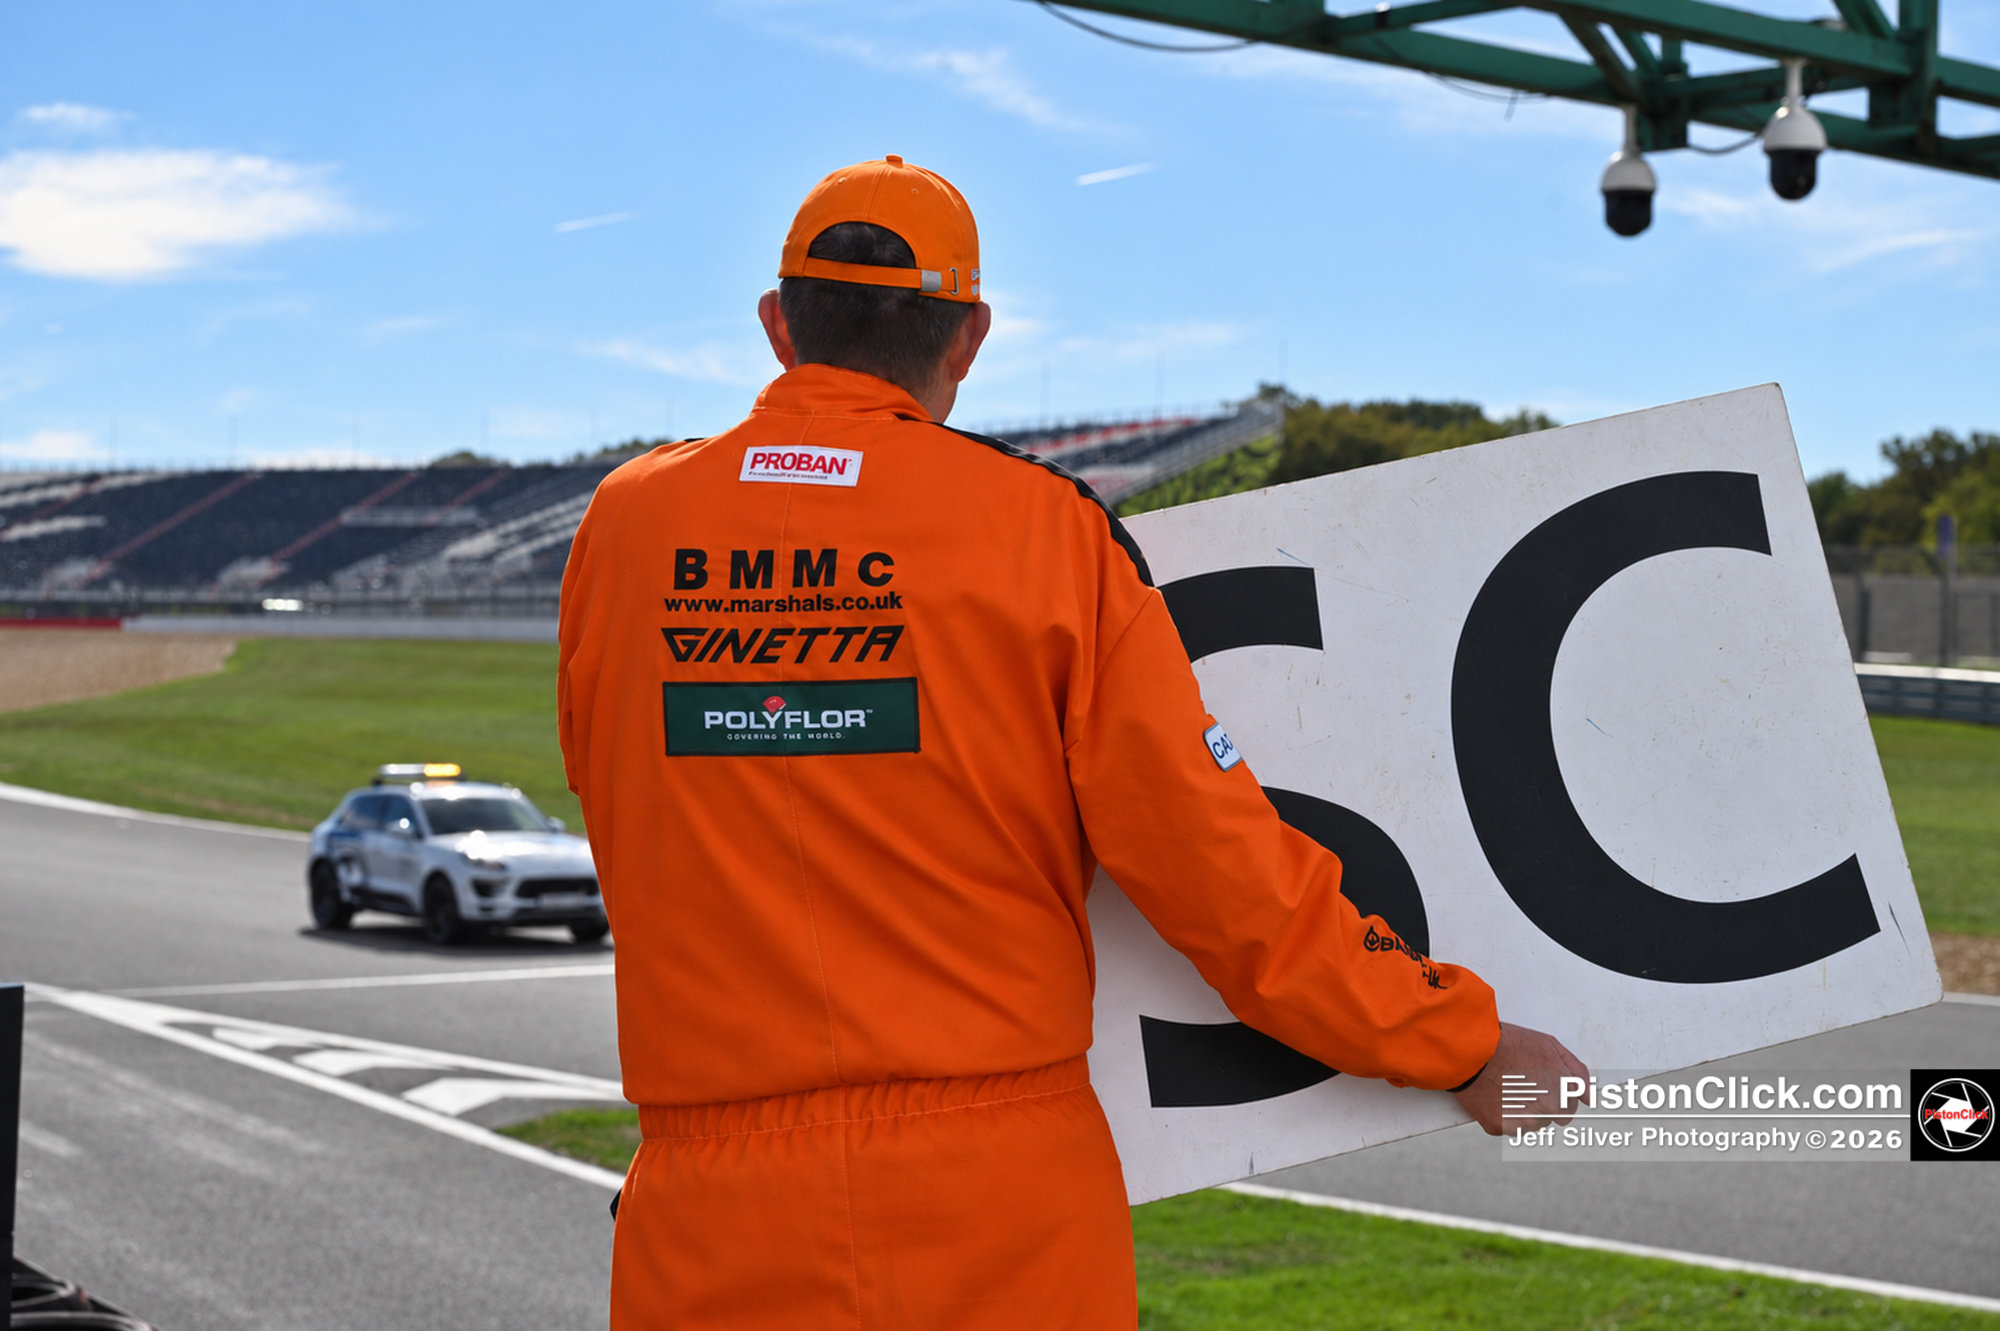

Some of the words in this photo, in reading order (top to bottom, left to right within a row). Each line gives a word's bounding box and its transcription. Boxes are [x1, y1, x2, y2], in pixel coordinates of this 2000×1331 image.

[750, 452, 847, 475] PROBAN
[664, 591, 903, 614] www.marshals.co.uk
[661, 625, 905, 664] GINETTA
[704, 709, 866, 730] POLYFLOR
[727, 733, 777, 741] COVERING
